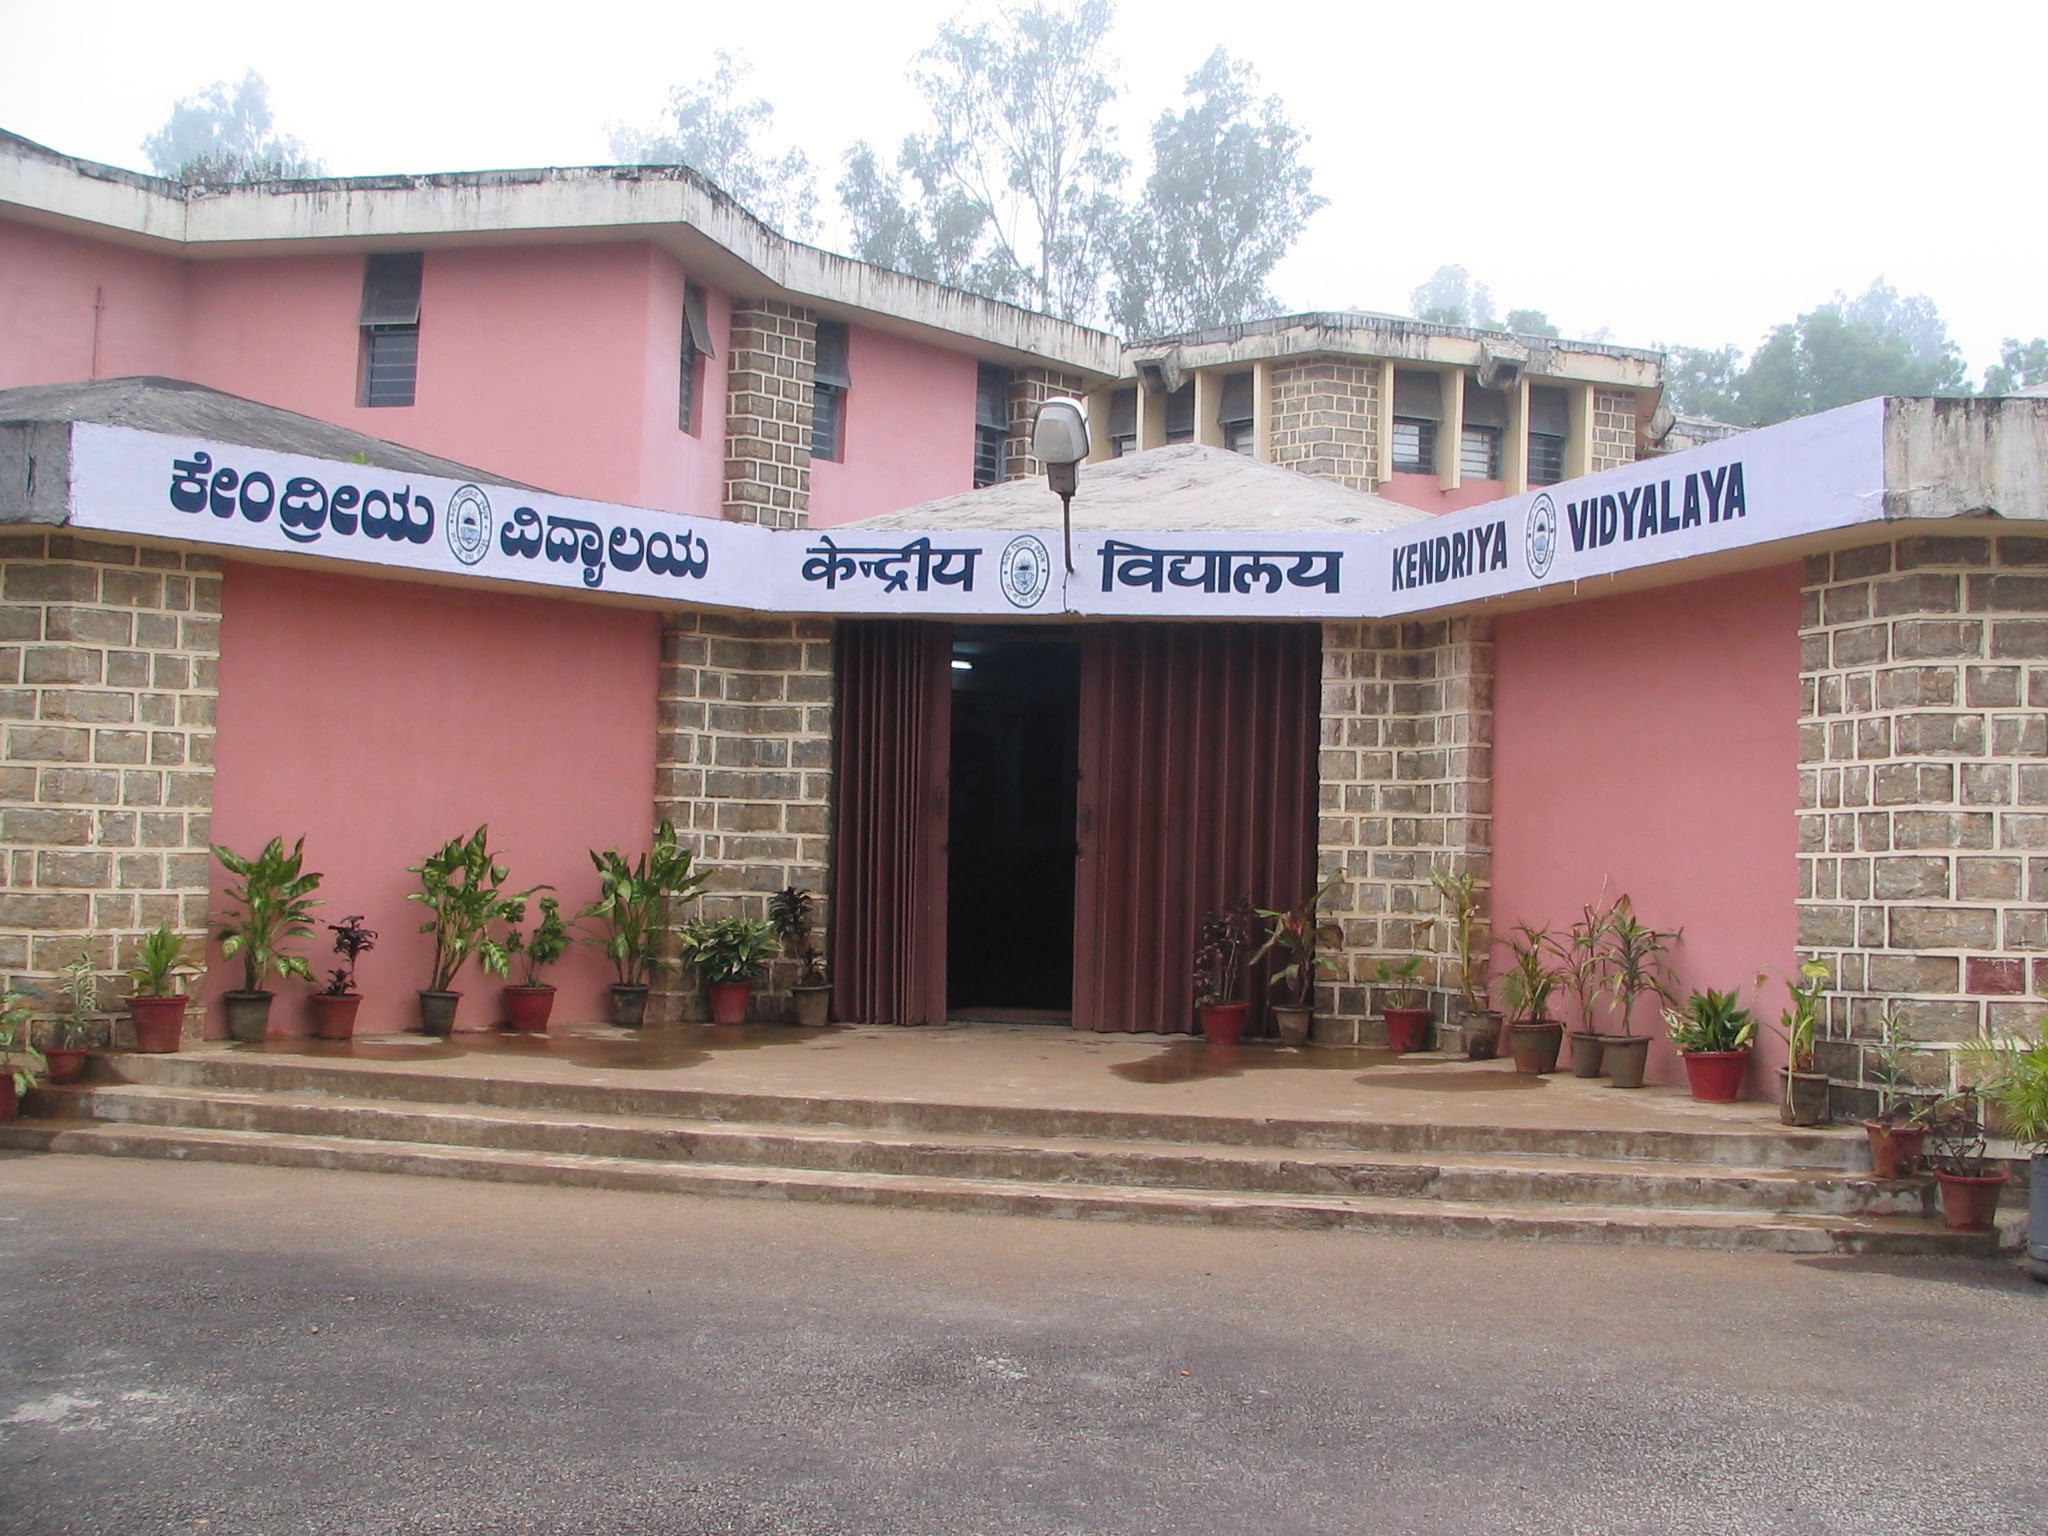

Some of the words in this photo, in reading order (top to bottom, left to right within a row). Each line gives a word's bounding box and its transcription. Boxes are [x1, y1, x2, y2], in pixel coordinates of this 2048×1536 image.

[170, 451, 435, 545] ಕೇಂದ್ರೀಯ
[500, 507, 709, 588] ವಿದ್ಯಾಲಯ
[801, 535, 983, 594] केन्द्रीय
[1097, 539, 1344, 594] विद्यालय
[1392, 520, 1508, 592] KENDRIYA
[1566, 461, 1746, 552] VIDYALAYA
